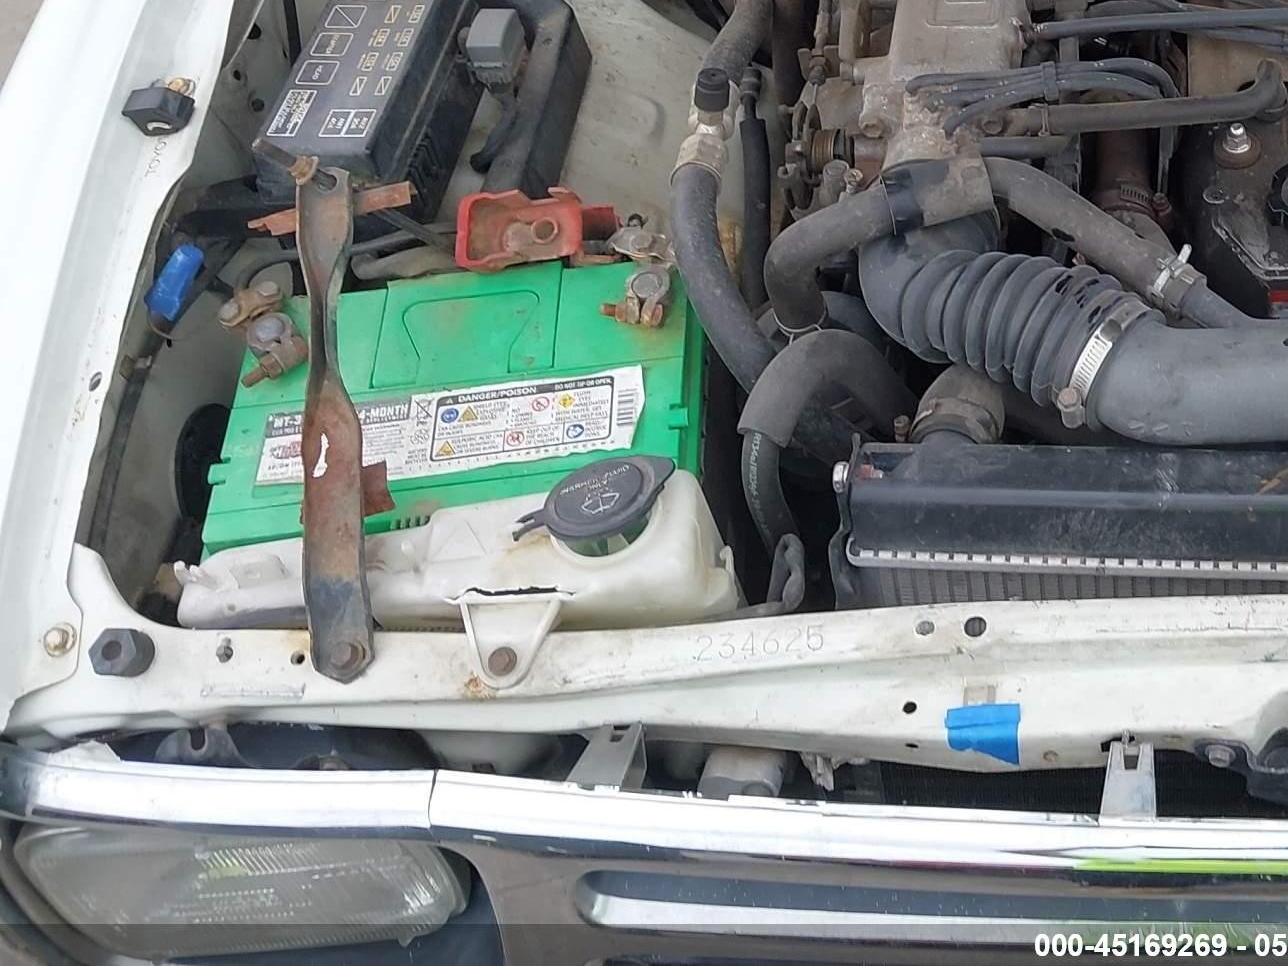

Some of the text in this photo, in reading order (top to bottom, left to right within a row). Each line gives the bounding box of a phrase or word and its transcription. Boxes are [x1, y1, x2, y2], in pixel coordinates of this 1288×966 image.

[458, 386, 537, 403] DANGER/POISON
[356, 404, 409, 419] 4-MONTH
[695, 624, 824, 662] 234625
